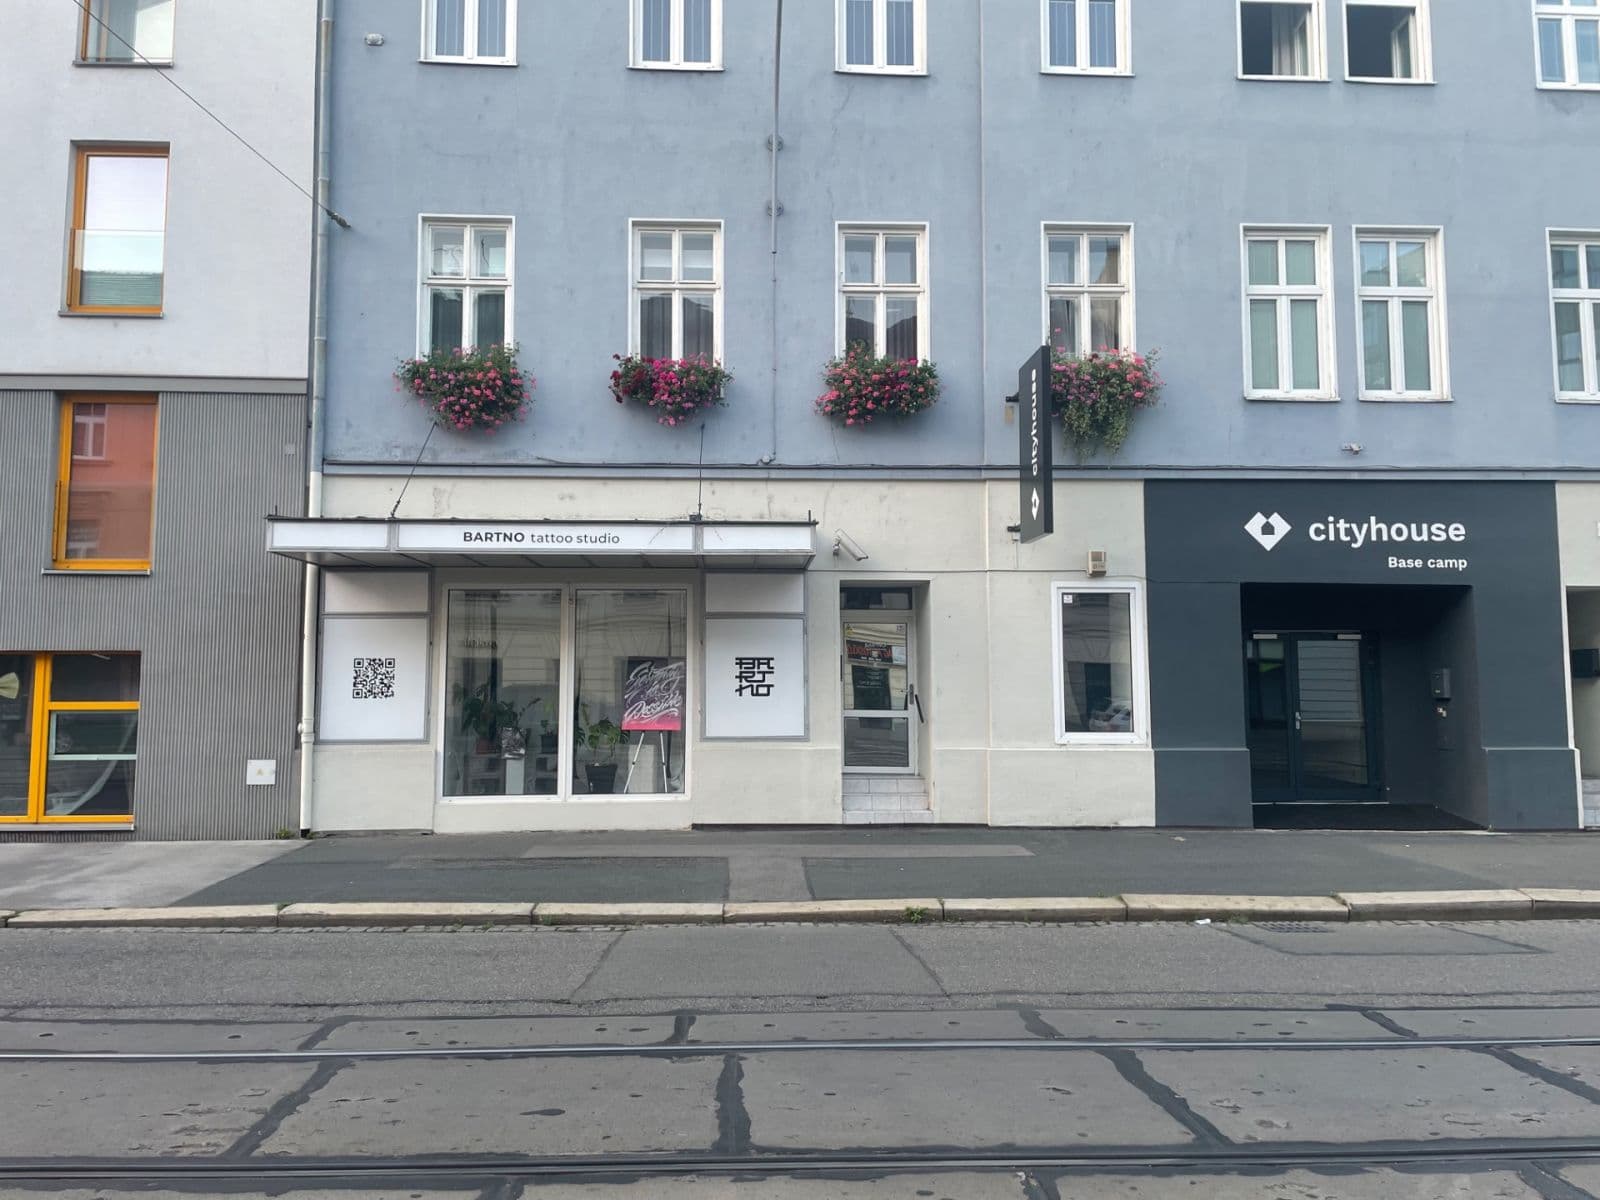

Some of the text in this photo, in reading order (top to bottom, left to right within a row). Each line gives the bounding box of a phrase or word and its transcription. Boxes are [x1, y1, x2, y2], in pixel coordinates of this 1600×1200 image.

[1030, 368, 1039, 477] cityhouse
[463, 531, 620, 544] BARTNO tattoo studio
[1308, 515, 1467, 549] cityhouse
[1387, 556, 1468, 571] Base camp
